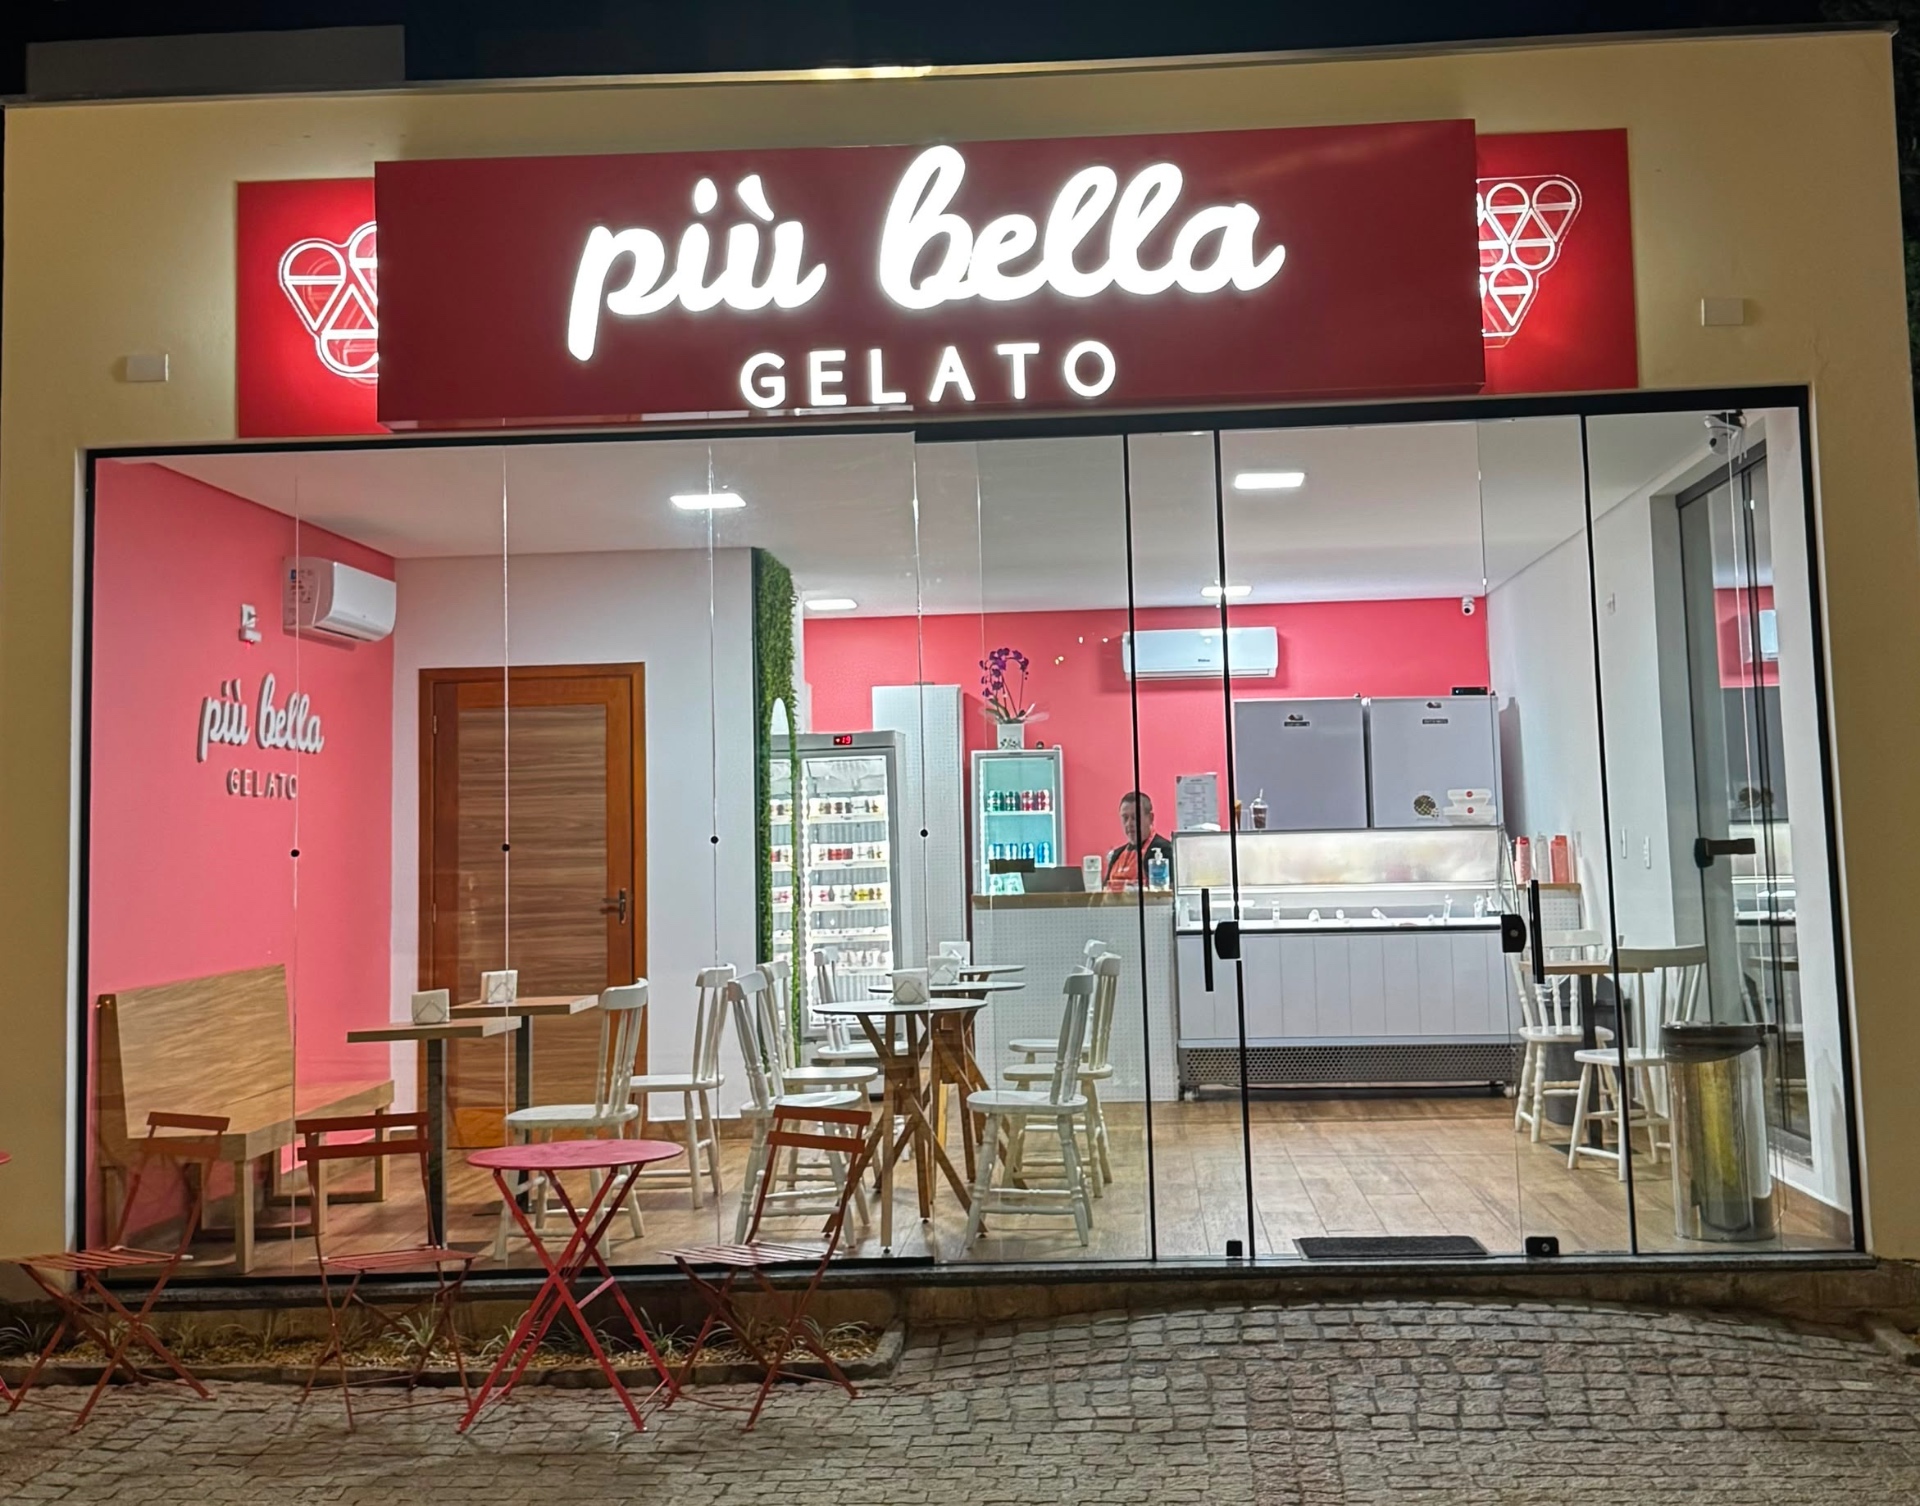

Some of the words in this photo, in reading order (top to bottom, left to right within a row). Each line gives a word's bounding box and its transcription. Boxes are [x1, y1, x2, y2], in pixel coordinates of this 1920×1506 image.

[567, 174, 827, 362] più
[877, 144, 1286, 310] bella
[739, 341, 1117, 409] GELATO
[198, 678, 251, 763] più
[256, 672, 325, 755] bella
[227, 767, 299, 799] GELATO
